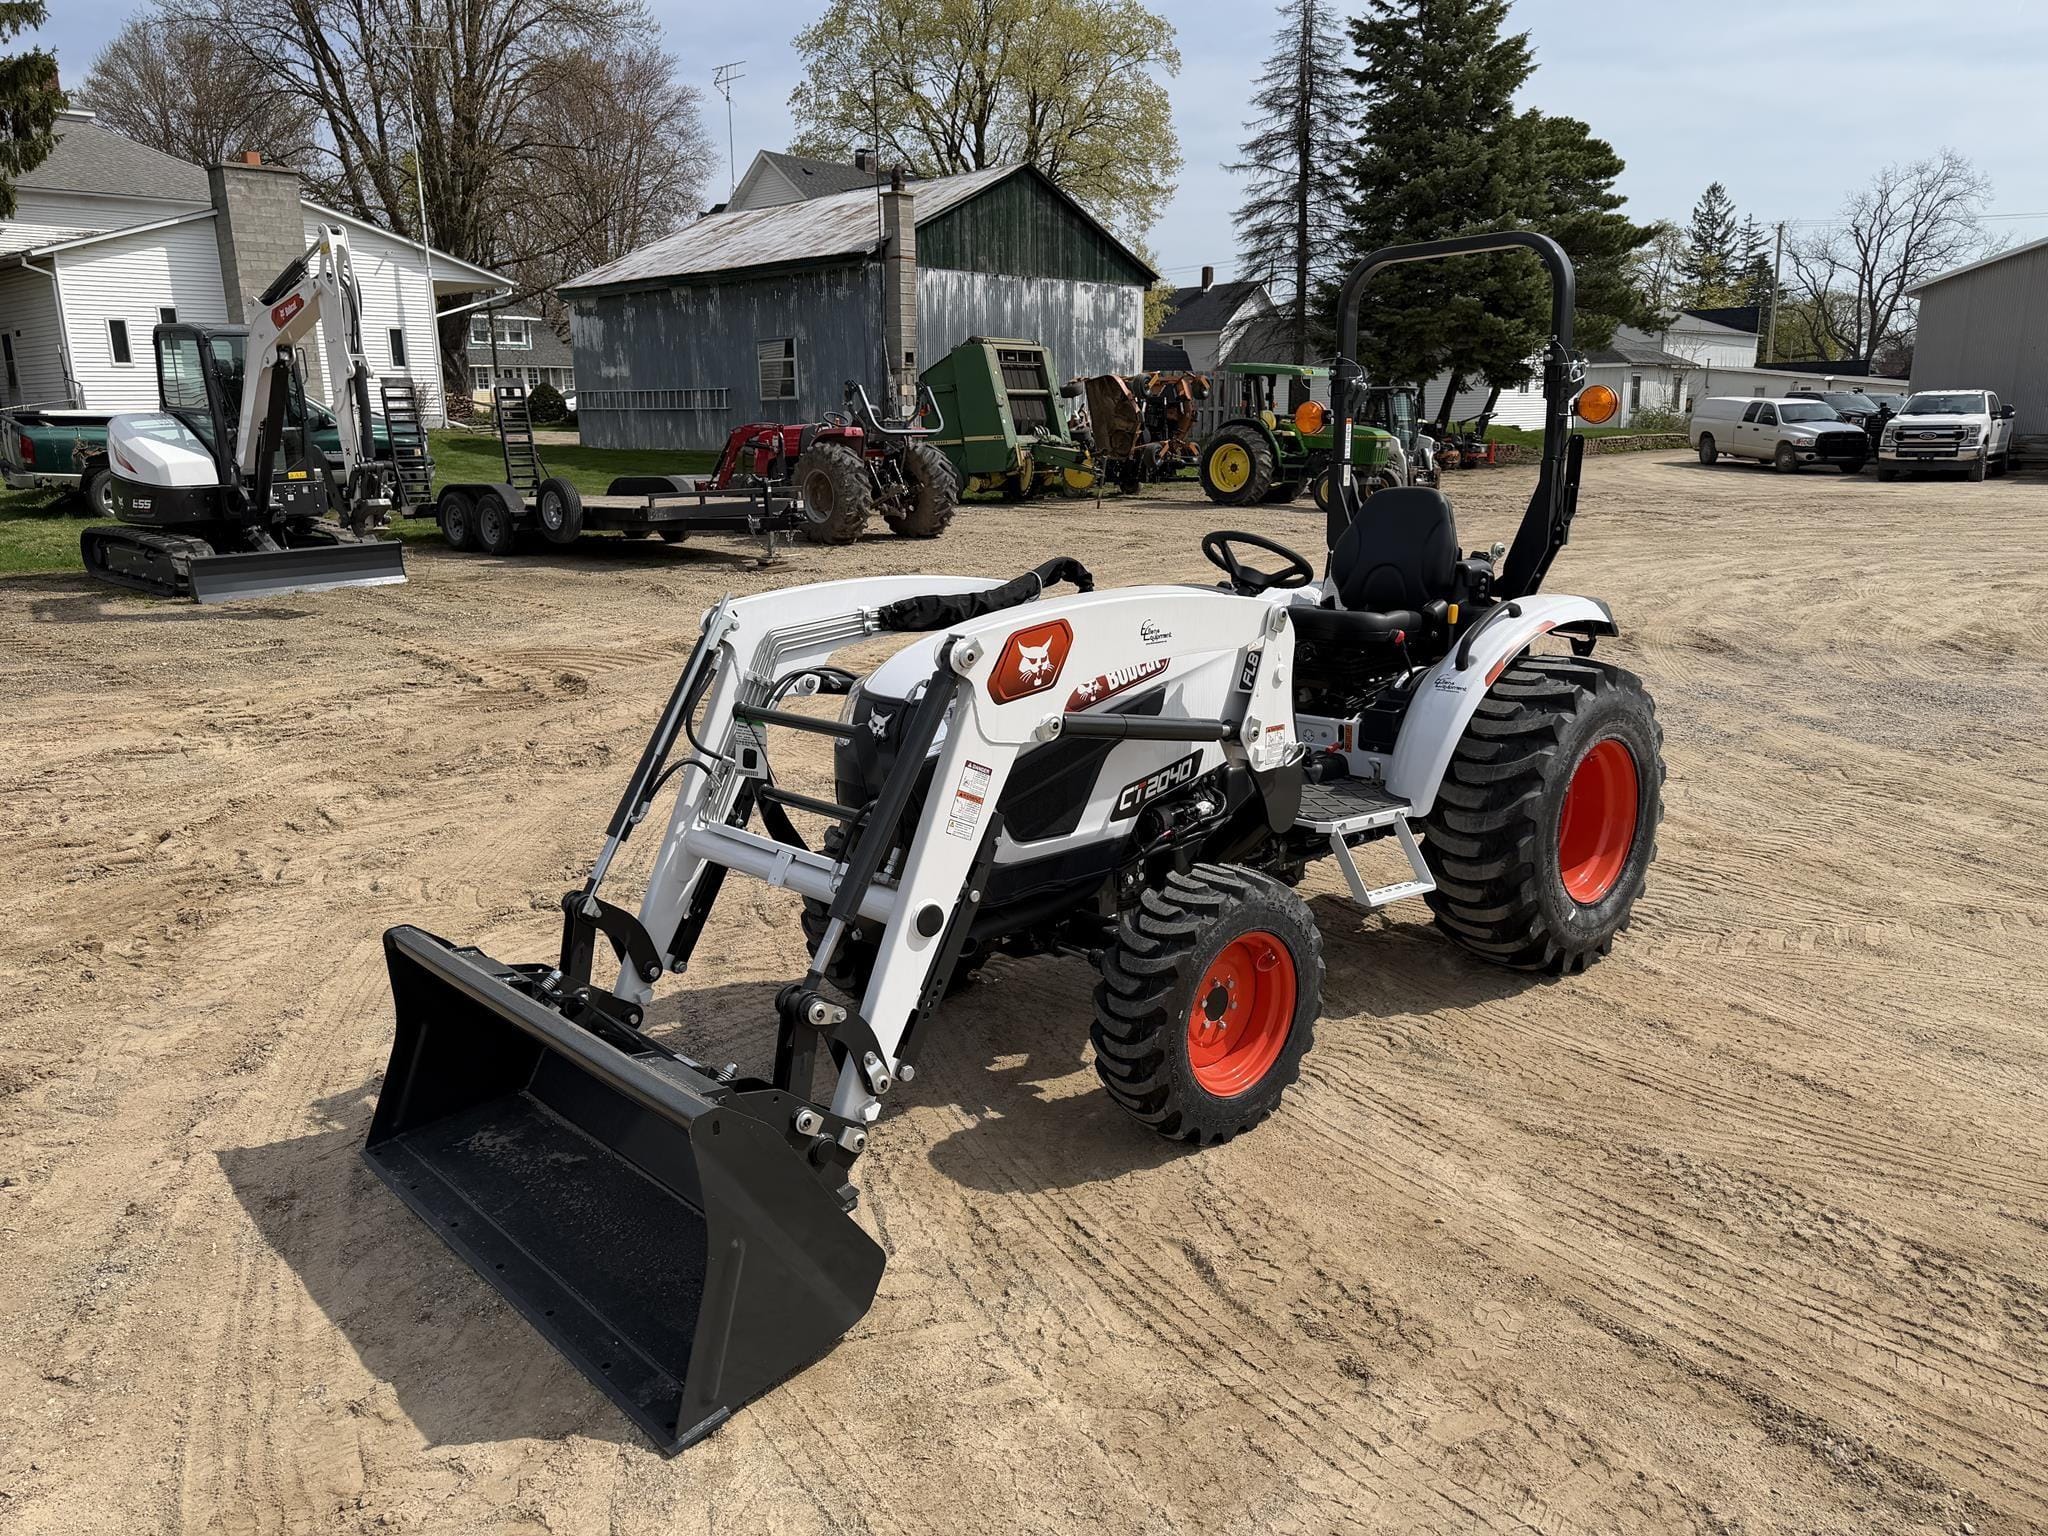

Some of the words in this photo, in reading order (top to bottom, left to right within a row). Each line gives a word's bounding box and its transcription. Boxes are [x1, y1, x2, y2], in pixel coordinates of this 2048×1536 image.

[132, 498, 152, 509] E55
[1242, 652, 1260, 687] FL8
[1119, 758, 1193, 811] CT2040
